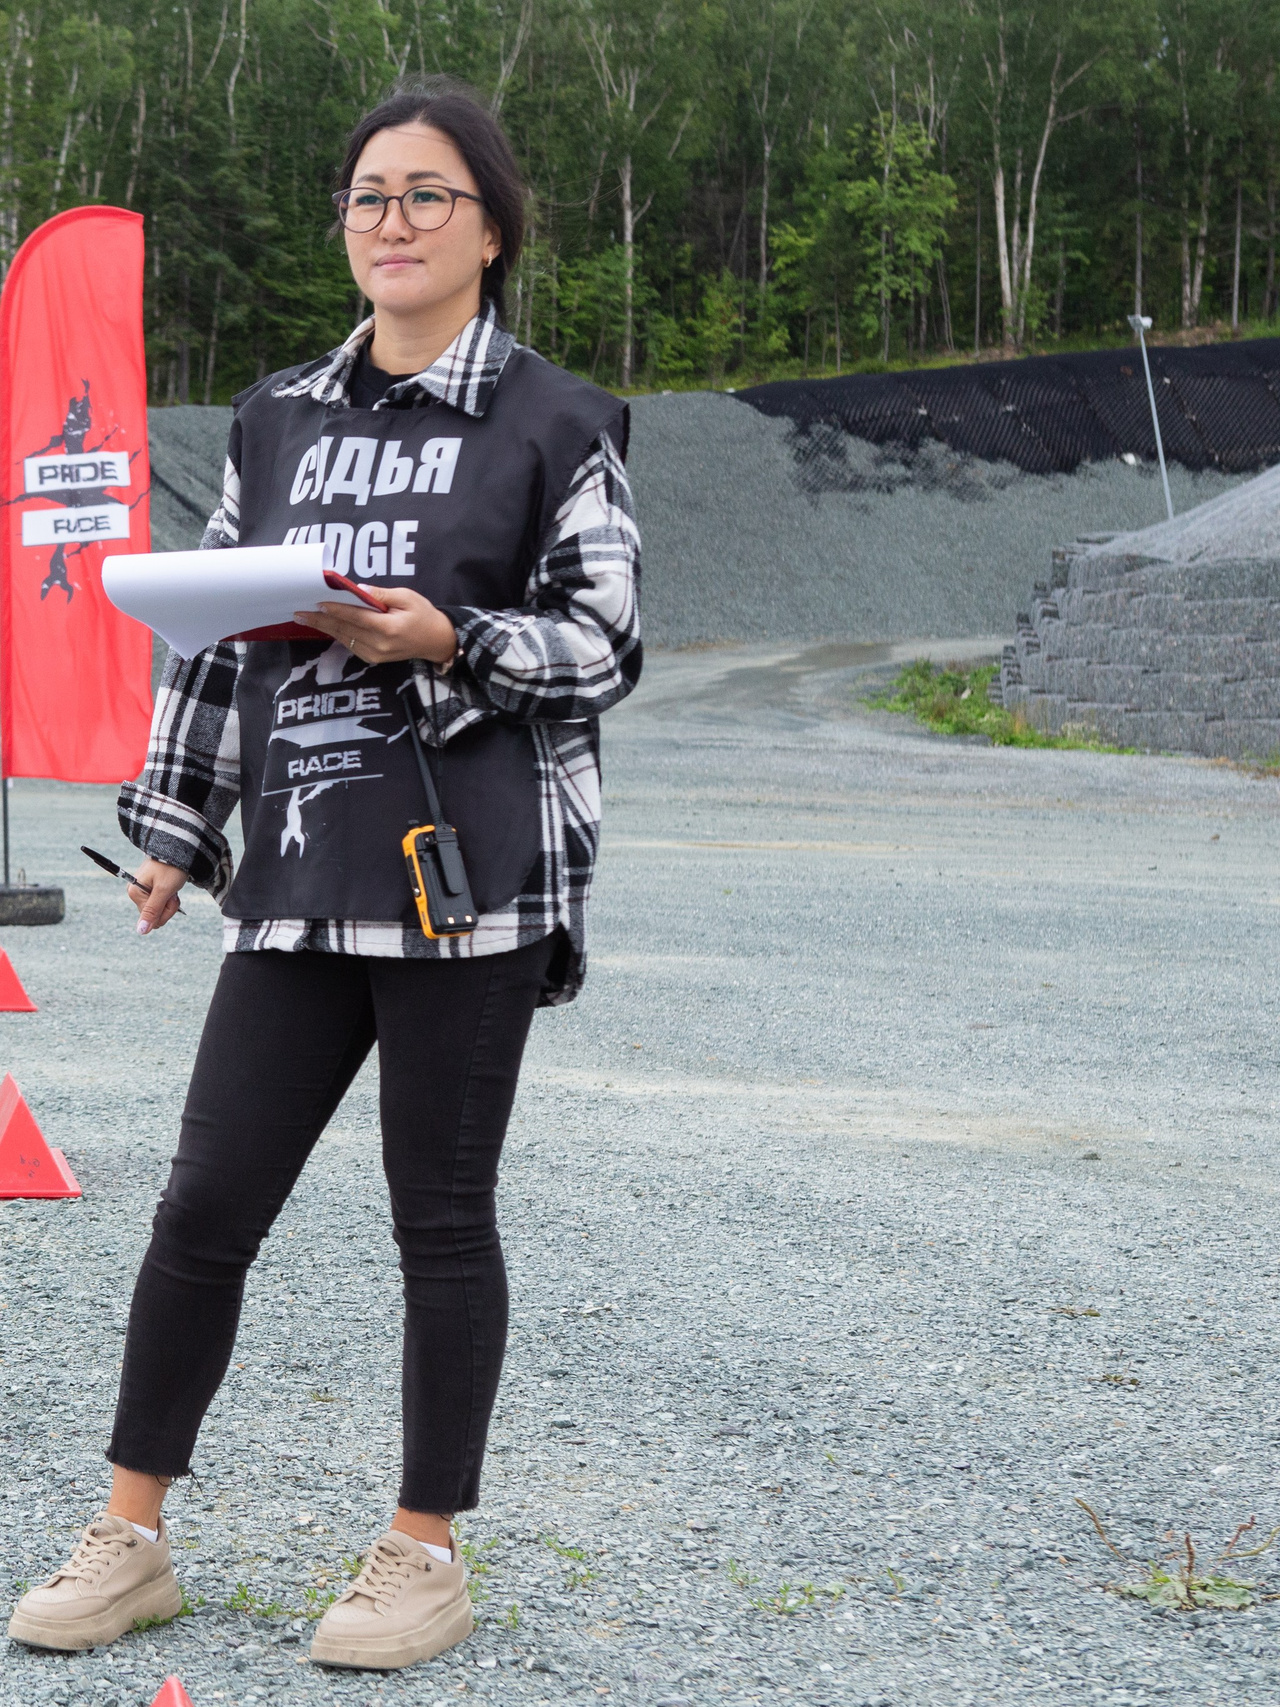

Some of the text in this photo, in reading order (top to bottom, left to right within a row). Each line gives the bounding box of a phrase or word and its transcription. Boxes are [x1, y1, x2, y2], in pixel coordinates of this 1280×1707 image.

[38, 461, 119, 486] PRIDE
[277, 687, 382, 724] PRIDE
[288, 750, 363, 779] RACE
